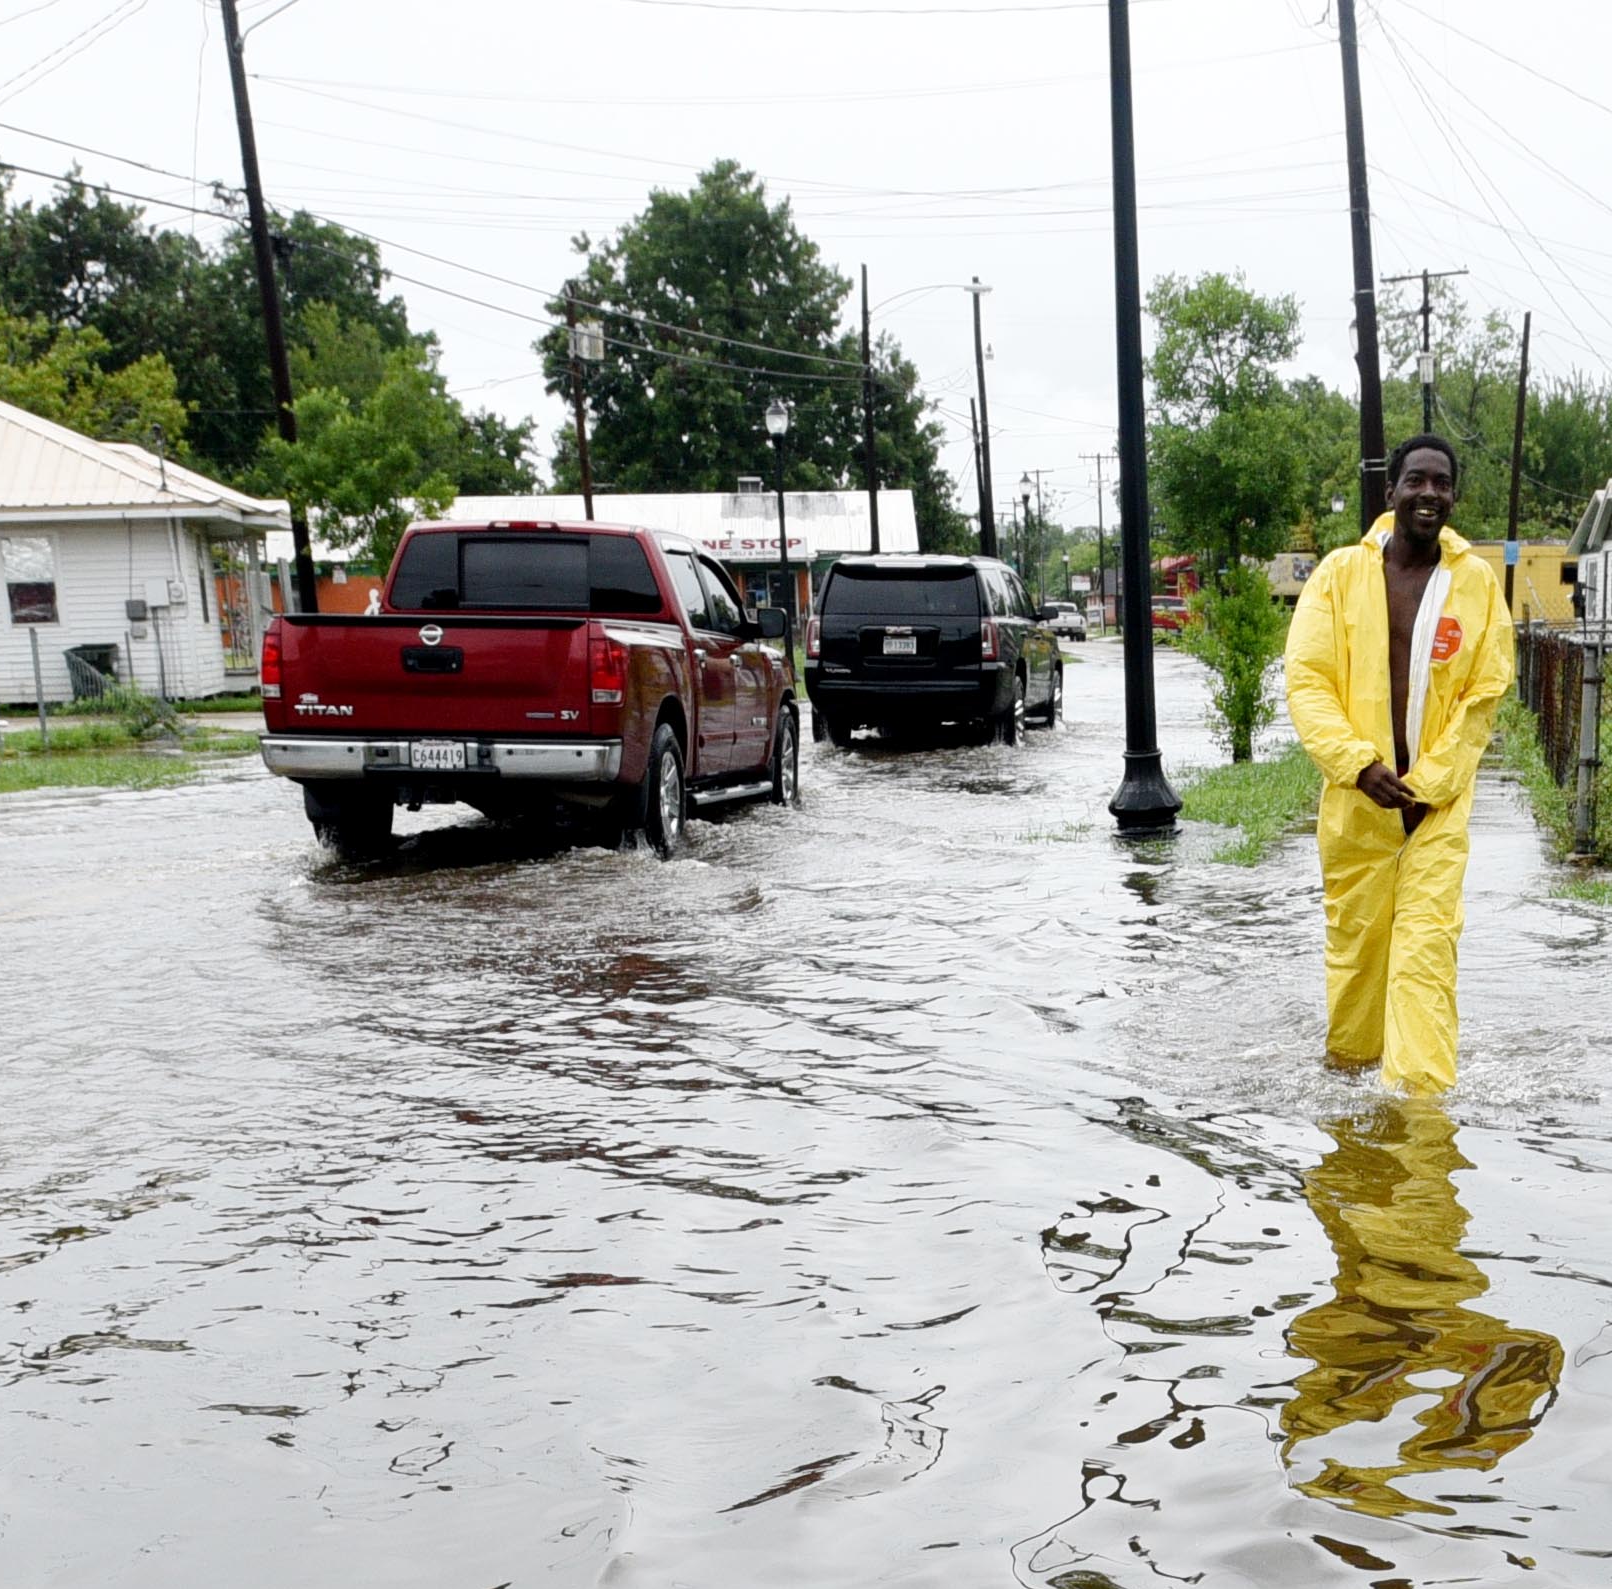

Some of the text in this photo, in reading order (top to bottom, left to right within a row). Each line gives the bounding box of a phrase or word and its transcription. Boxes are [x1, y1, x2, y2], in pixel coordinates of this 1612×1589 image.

[702, 538, 802, 550] NE STOP
[294, 704, 353, 716] TITAN
[560, 710, 580, 720] SV
[413, 748, 463, 762] C644419
